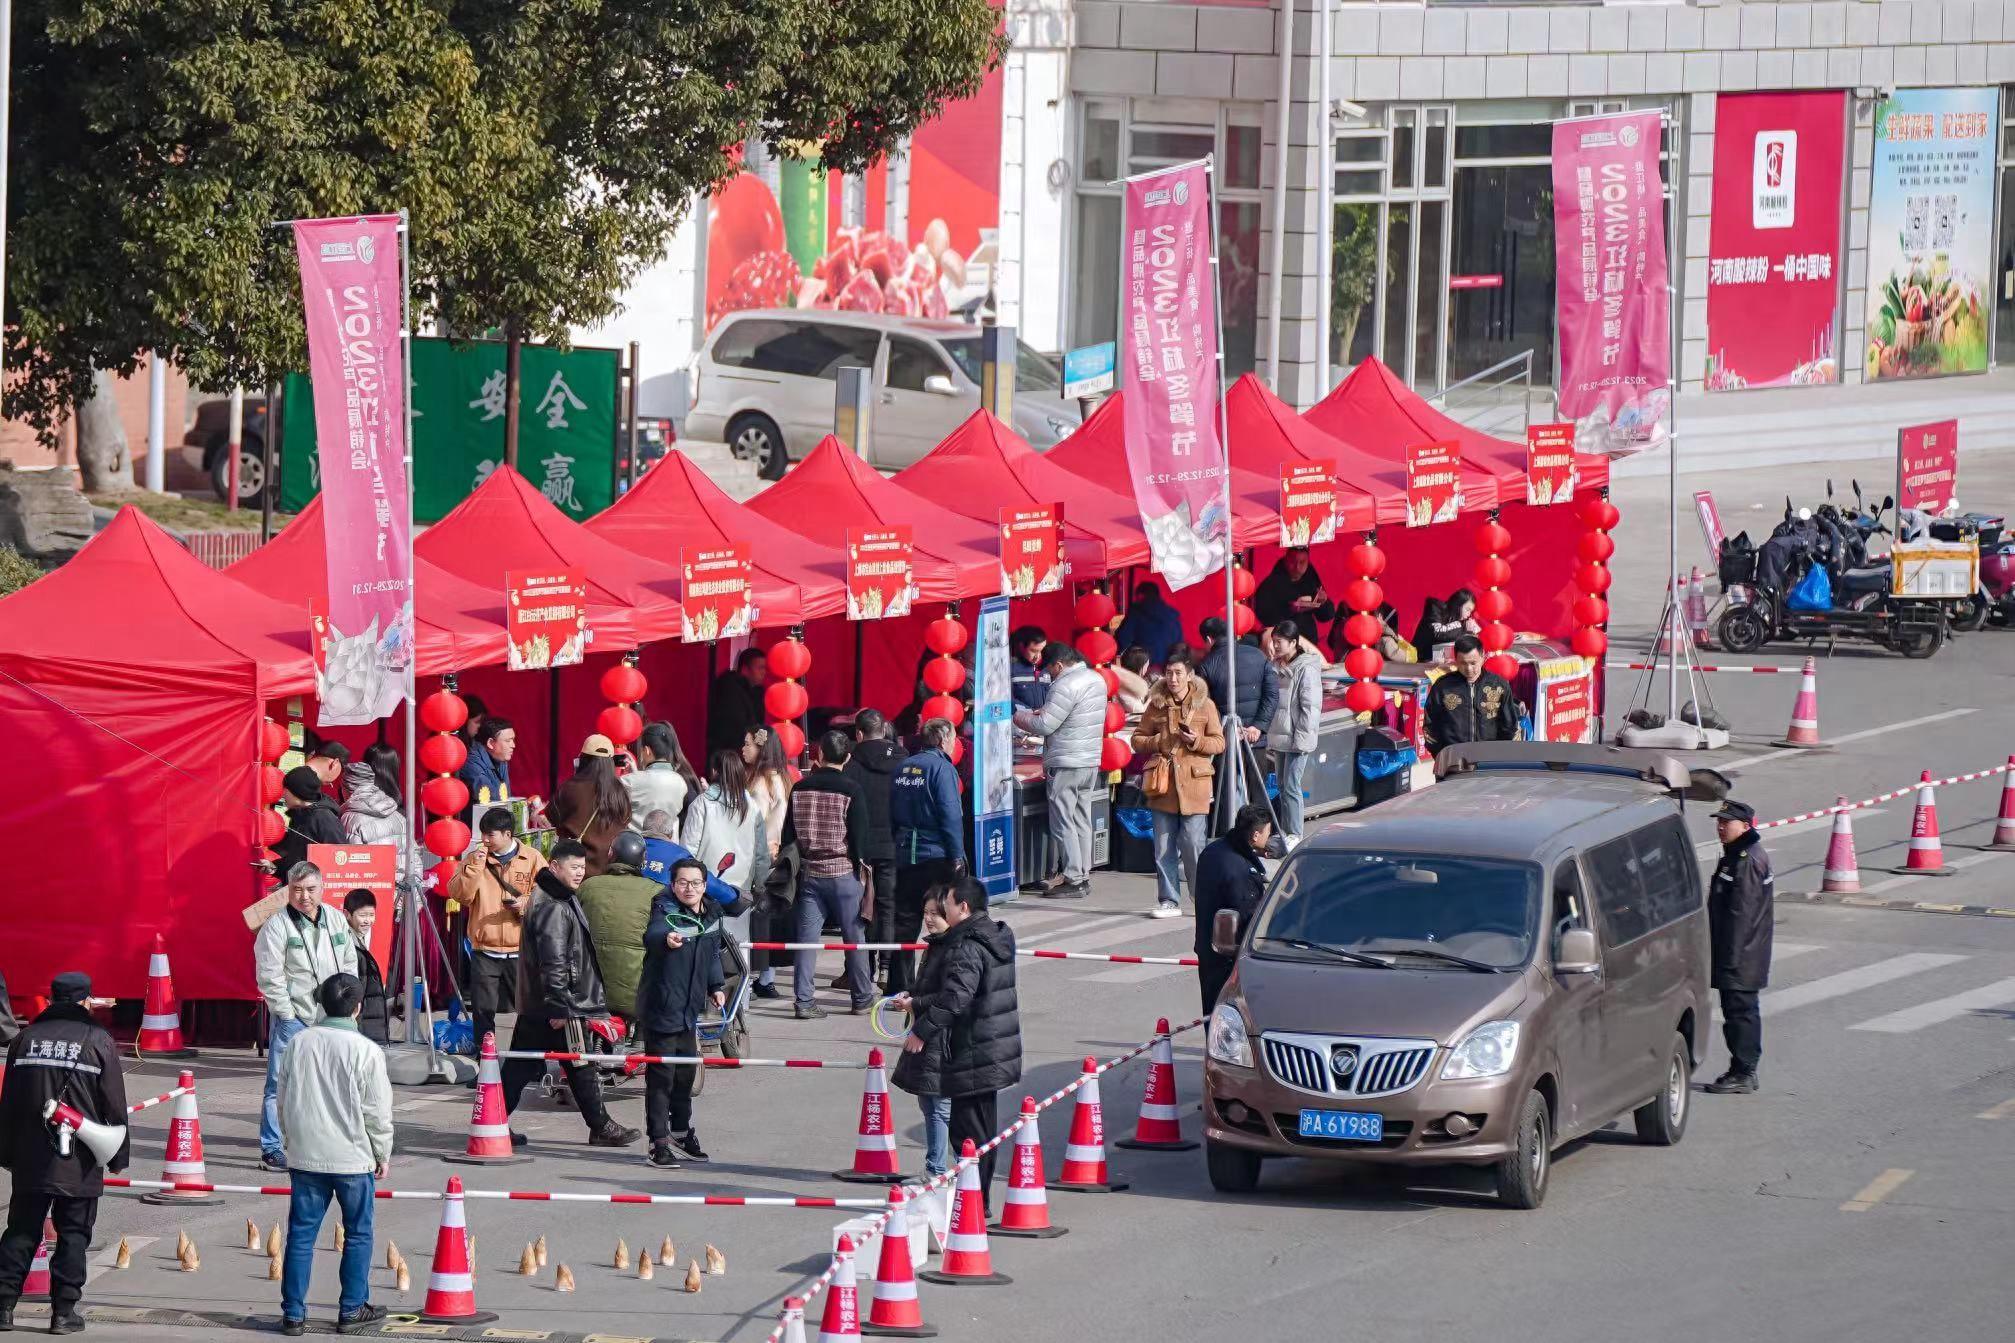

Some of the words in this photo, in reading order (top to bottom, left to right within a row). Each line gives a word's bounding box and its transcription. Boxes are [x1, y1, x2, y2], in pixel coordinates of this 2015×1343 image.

[1888, 113, 1934, 142] 生鲜蔬果
[1942, 112, 1988, 140] 配送到家
[1710, 256, 1769, 286] 河南酸辣粉
[1773, 252, 1831, 281] 一桶中国味
[26, 1039, 82, 1060] 上海保安
[867, 1093, 881, 1134] 江杨农产
[178, 1119, 192, 1160] 江杨农产
[1021, 1146, 1034, 1187] 江杨农产
[840, 1287, 855, 1333] 江杨农产
